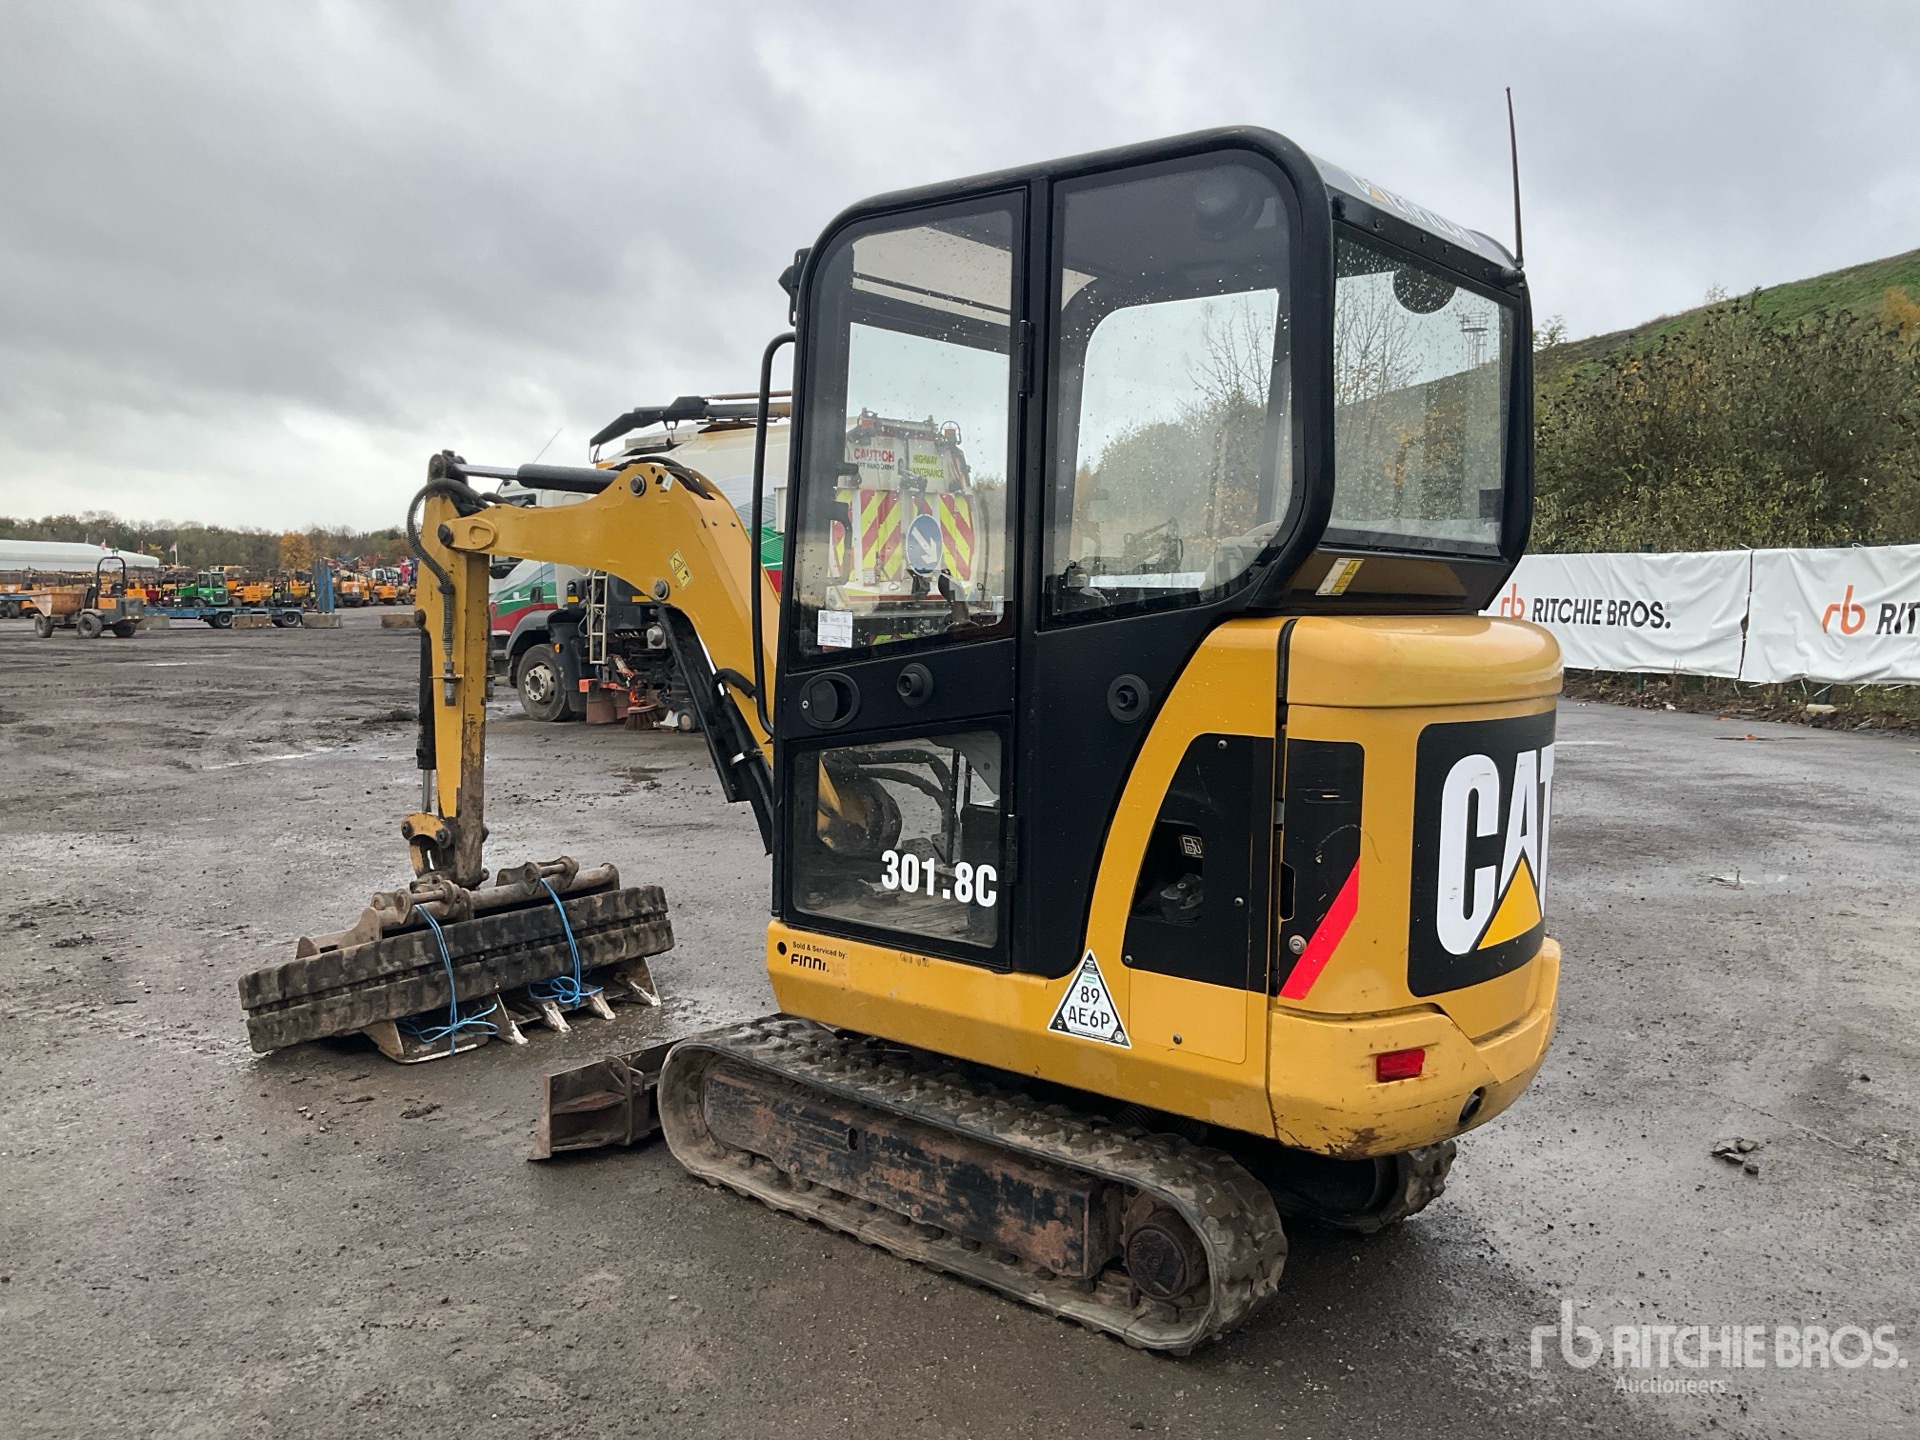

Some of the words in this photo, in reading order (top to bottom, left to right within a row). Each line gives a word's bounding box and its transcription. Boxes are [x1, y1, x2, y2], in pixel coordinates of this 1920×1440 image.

[854, 448, 895, 463] CAUTION
[1532, 597, 1603, 625] RITCHIE
[1436, 742, 1555, 955] CAT
[881, 849, 997, 908] 301.8C
[792, 941, 806, 951] Sold
[812, 945, 838, 957] Serviced
[1080, 985, 1100, 1005] 89
[1068, 1005, 1110, 1030] AE6P
